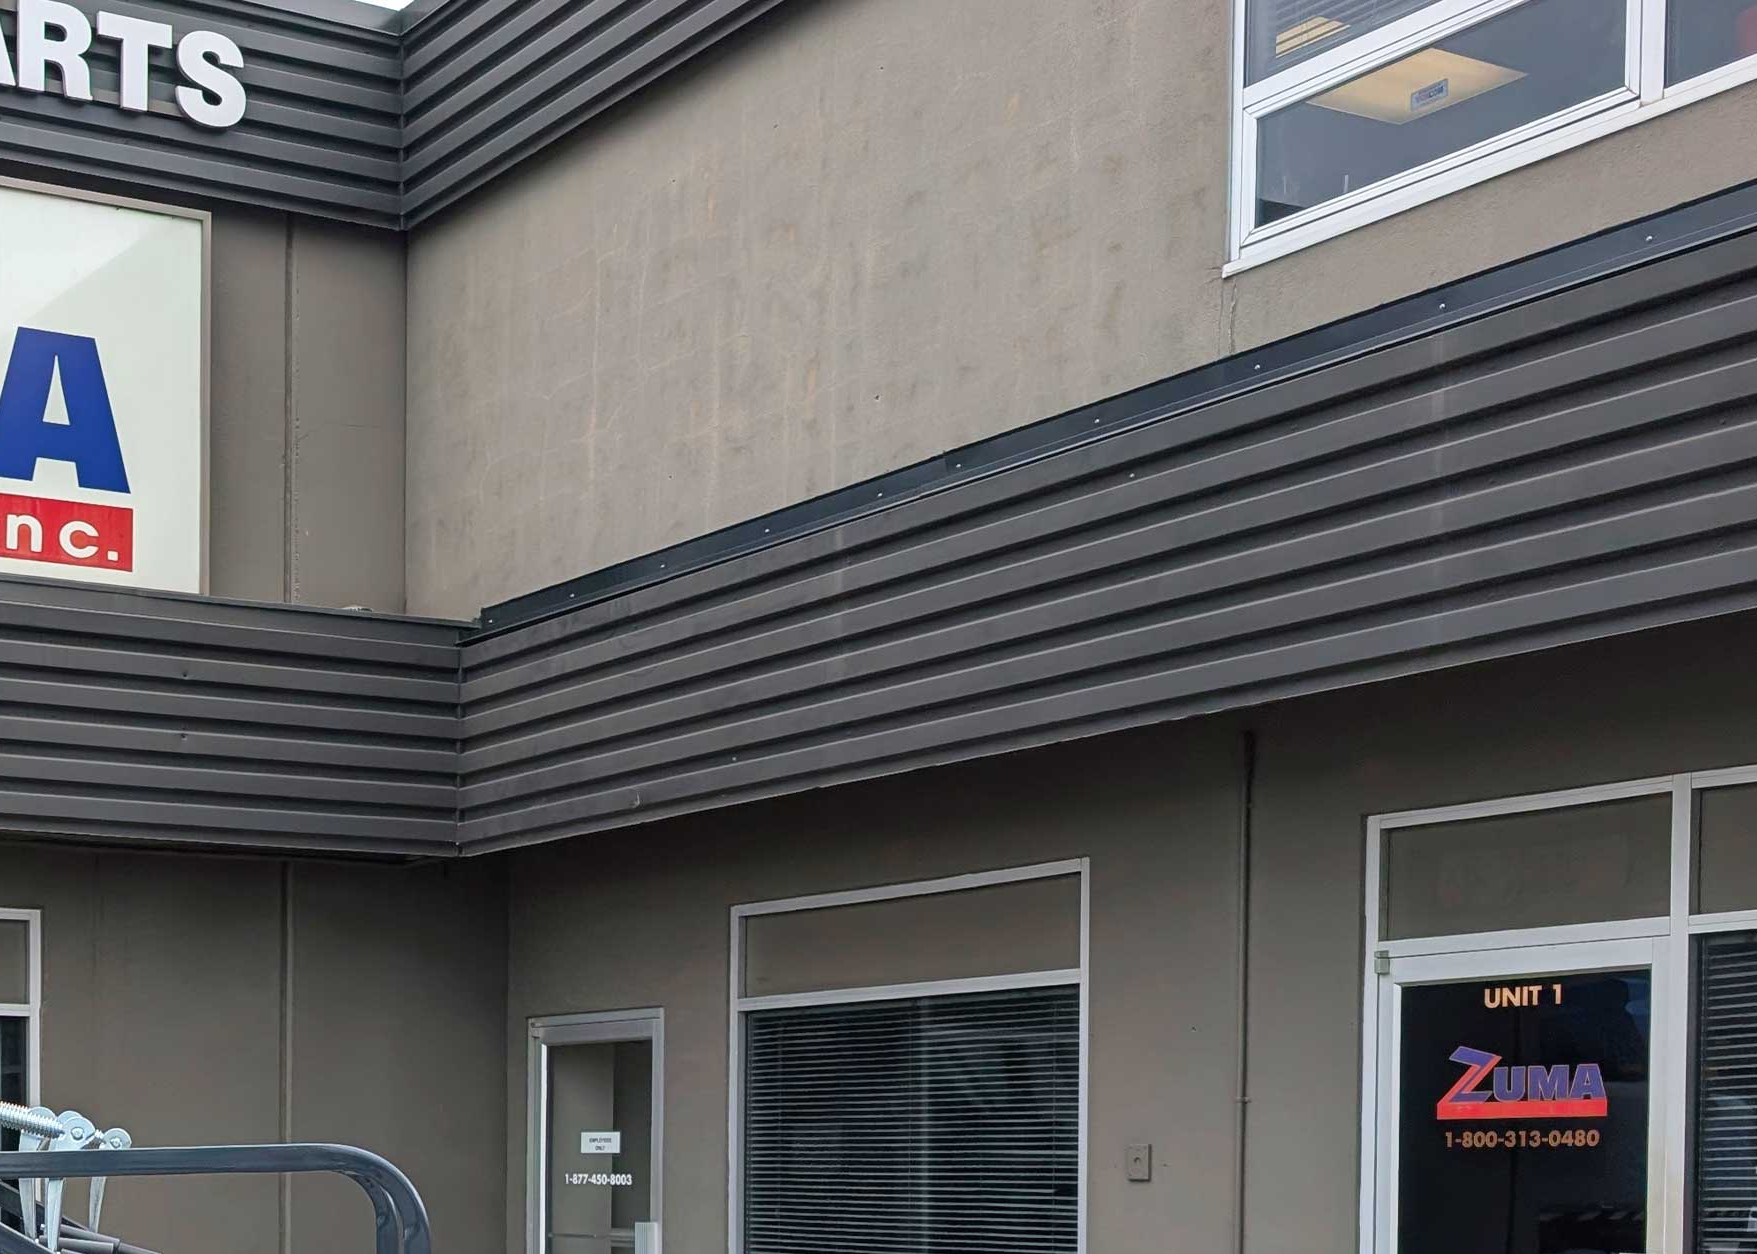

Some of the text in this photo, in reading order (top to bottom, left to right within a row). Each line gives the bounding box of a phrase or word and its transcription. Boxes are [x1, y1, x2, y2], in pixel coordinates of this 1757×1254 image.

[1483, 983, 1563, 1009] UNIT 1
[1448, 1045, 1608, 1105] ZUMA
[1444, 1129, 1601, 1149] 1-800-313-0480
[564, 1172, 633, 1186] 1-877-450-8003
